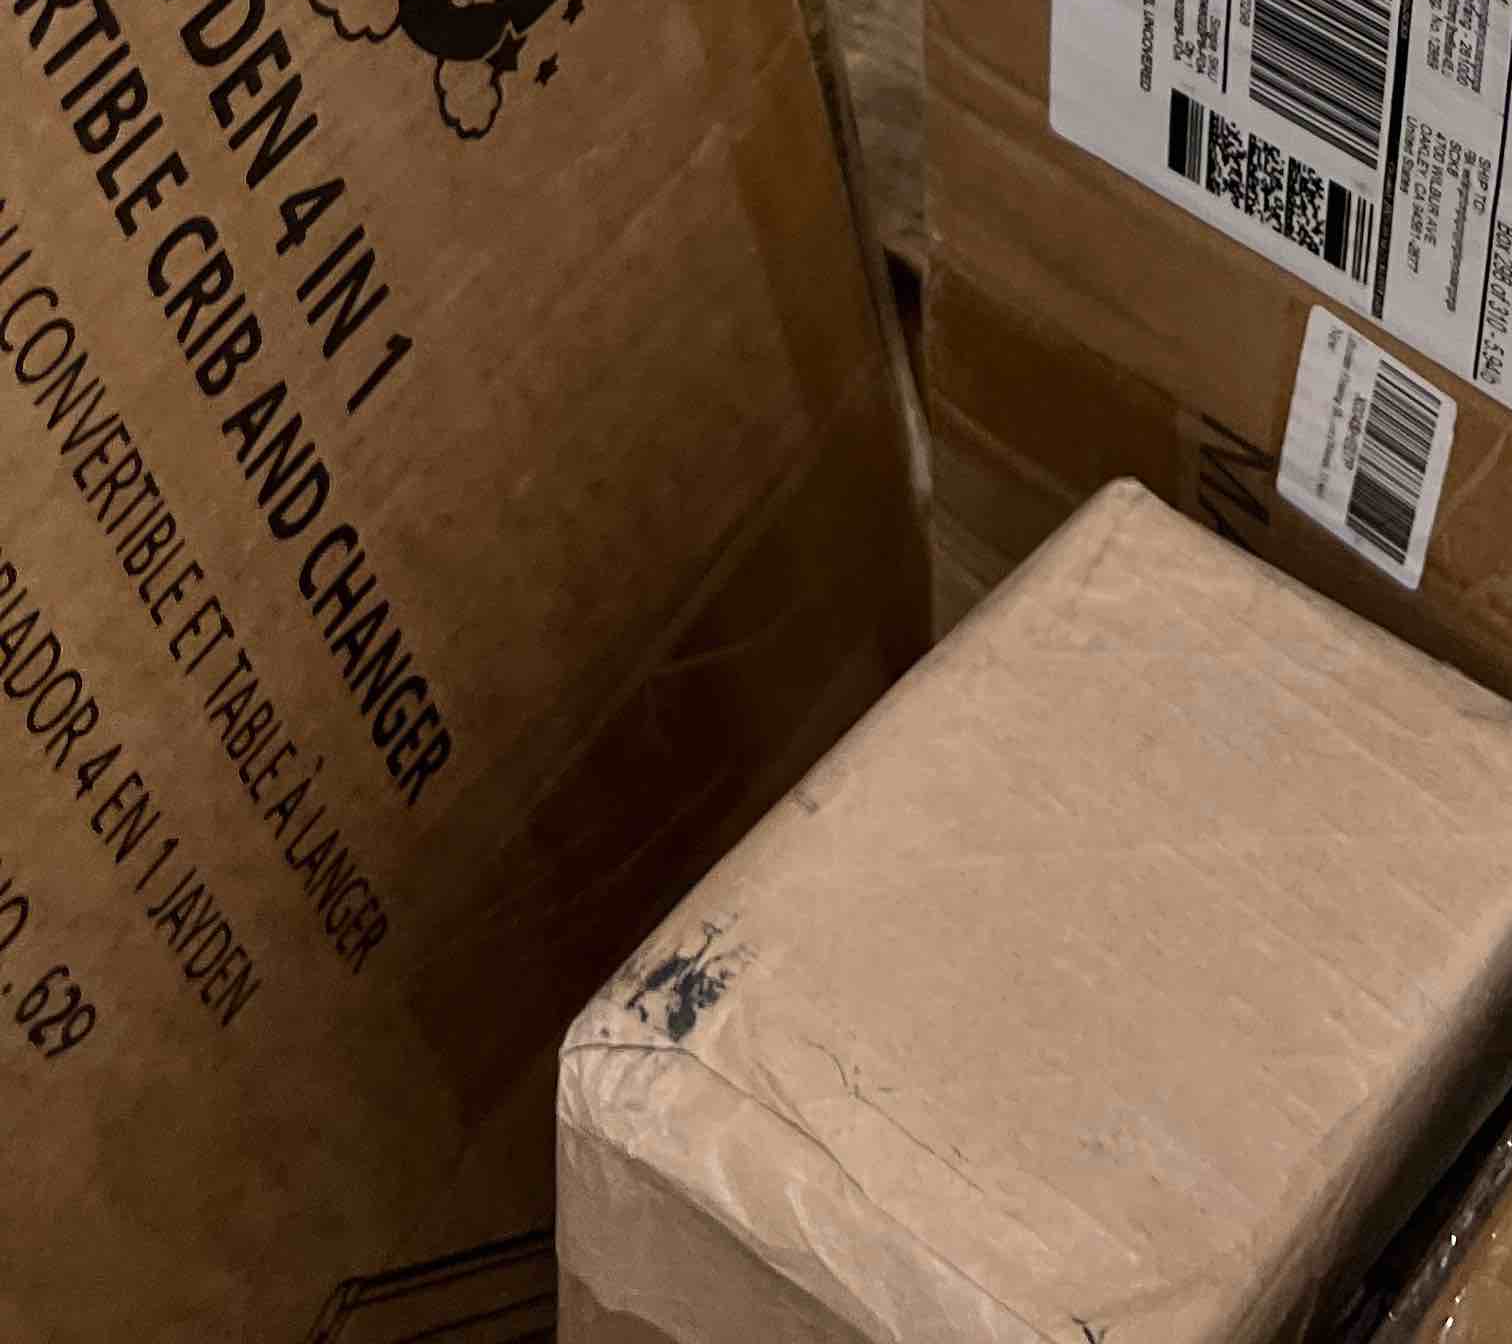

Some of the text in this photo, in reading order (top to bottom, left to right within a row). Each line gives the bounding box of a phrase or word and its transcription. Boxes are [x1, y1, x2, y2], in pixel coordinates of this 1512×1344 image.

[276, 176, 346, 256] 4
[296, 224, 390, 360] IN
[1485, 299, 1510, 334] 310
[1489, 282, 1511, 307] of
[346, 333, 413, 416] 1
[147, 215, 263, 397] CRIB
[221, 380, 331, 541] AND
[299, 523, 452, 806] CHANGER
[0, 287, 205, 627] CONVERTIBLE
[168, 596, 235, 676] ET
[203, 647, 297, 803] TABLE
[284, 804, 390, 975] LANGER
[75, 742, 123, 800] 4
[89, 771, 161, 865] EN
[134, 838, 180, 892] 1
[146, 866, 262, 1028] JAYDEN
